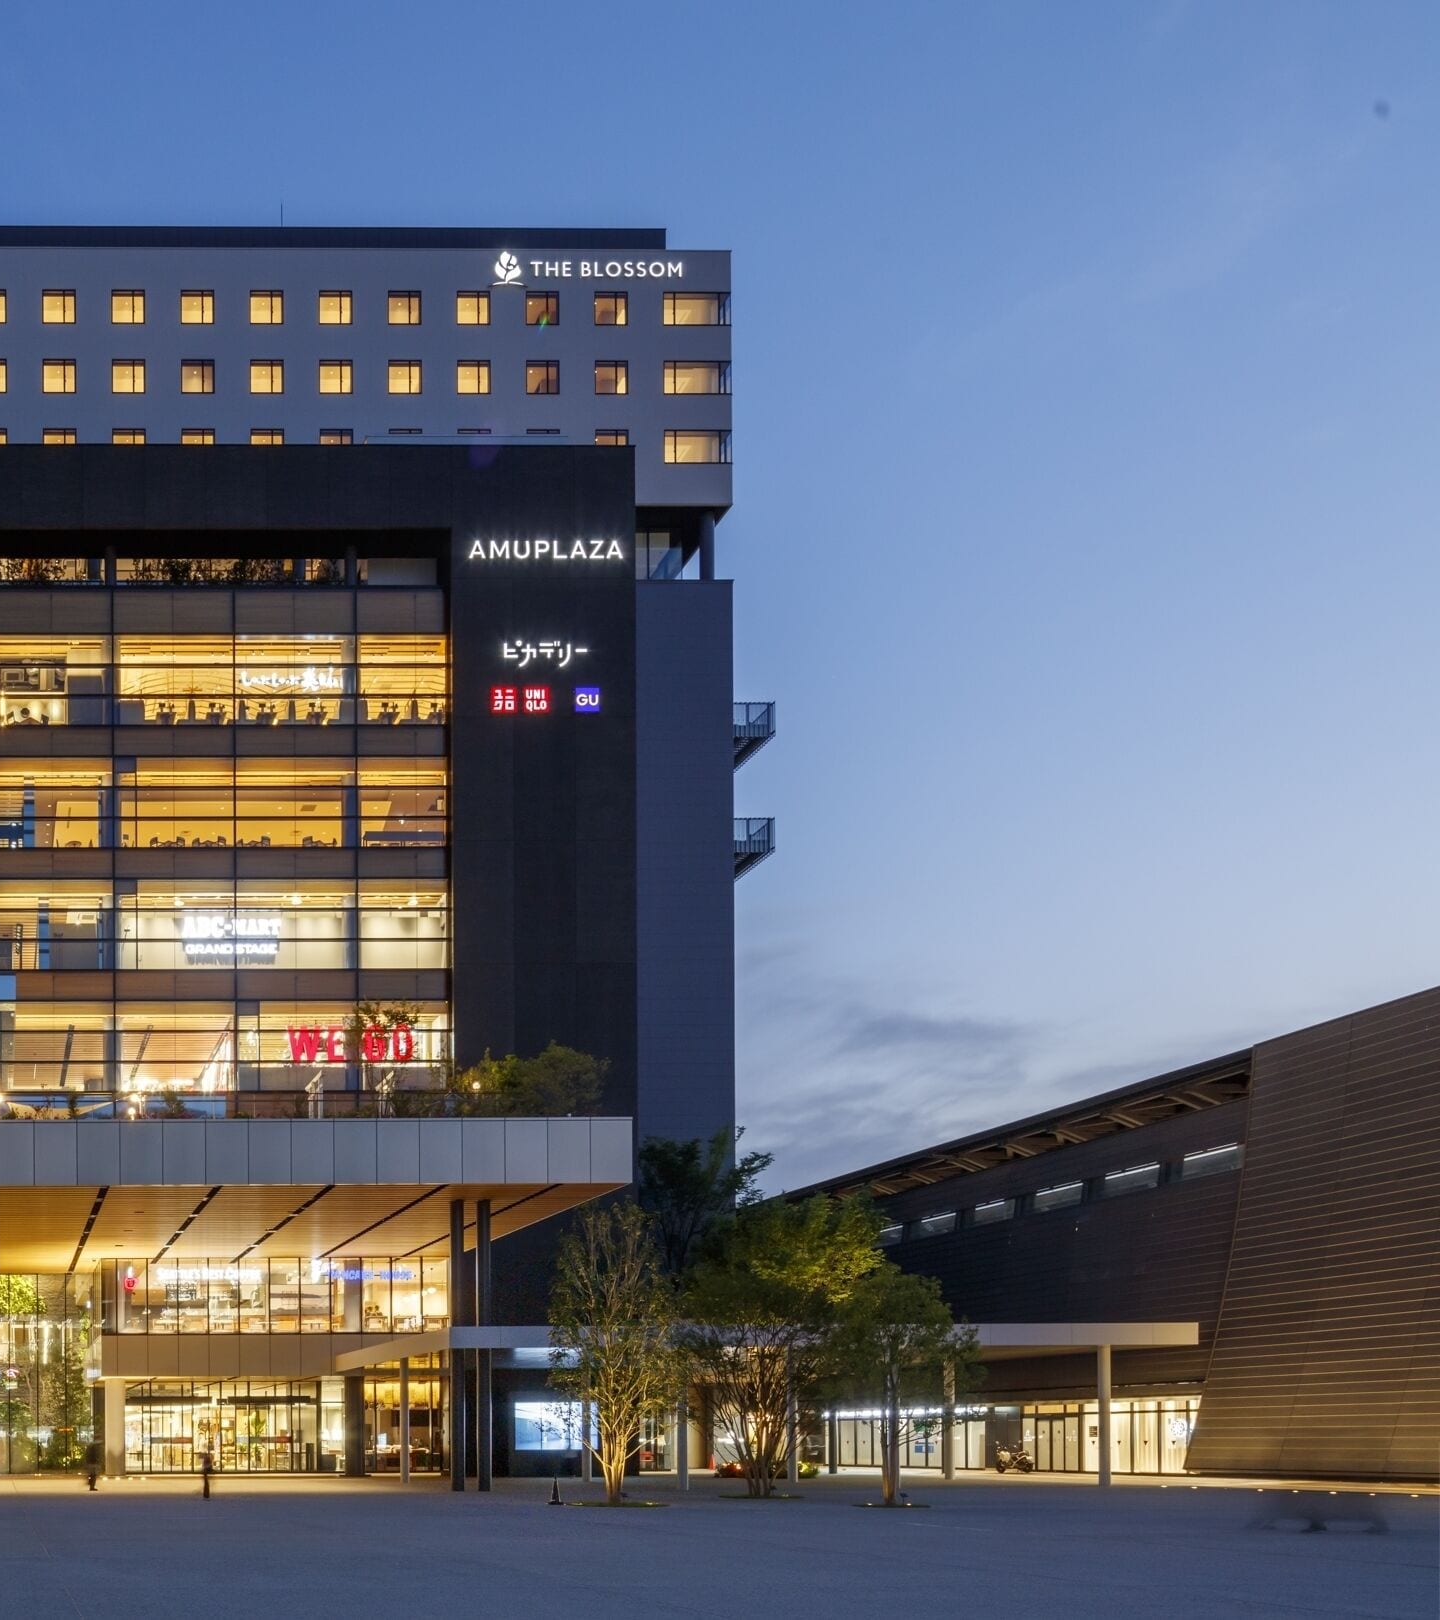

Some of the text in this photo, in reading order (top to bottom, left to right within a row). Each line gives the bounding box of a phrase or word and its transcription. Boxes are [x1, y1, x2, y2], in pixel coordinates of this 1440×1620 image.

[530, 261, 683, 277] THE BLOSSOM
[468, 539, 624, 560] AMUPLAZA
[502, 639, 589, 668] ピカデリー
[576, 693, 599, 706] GU
[182, 916, 281, 938] ABC-MART
[185, 943, 278, 955] GRAND STAGE
